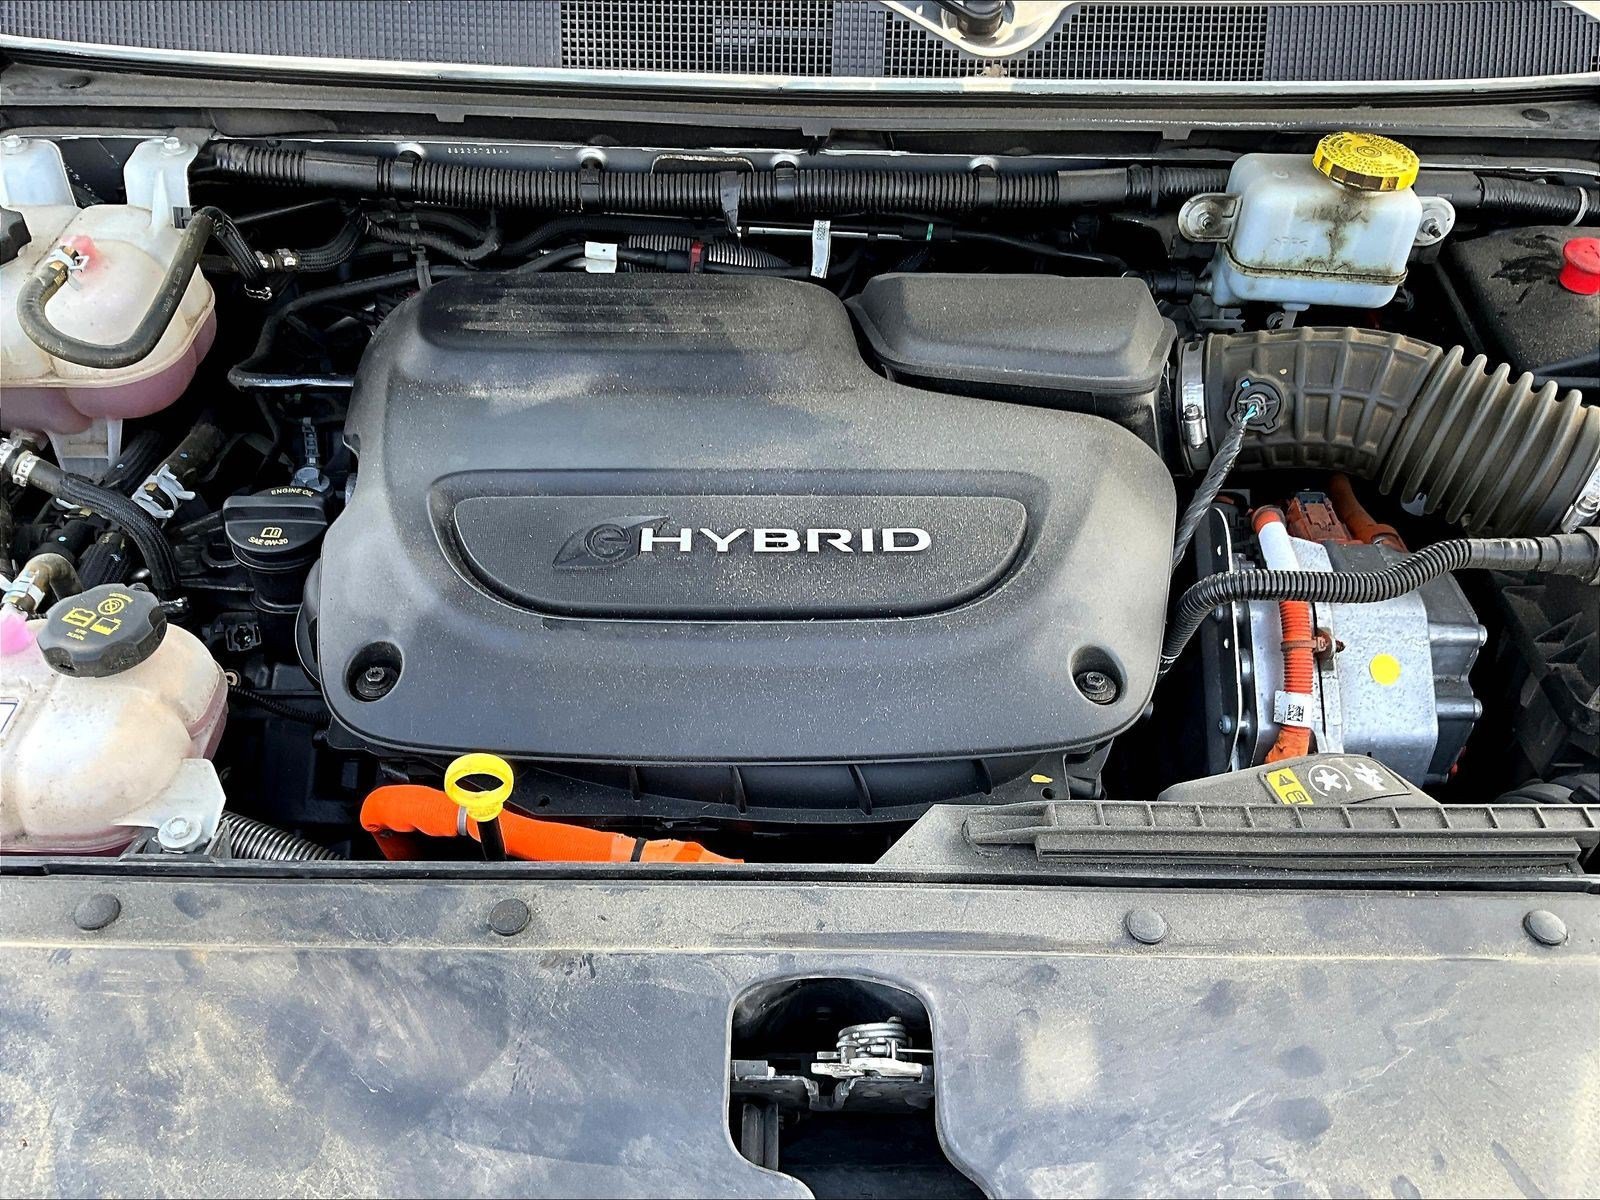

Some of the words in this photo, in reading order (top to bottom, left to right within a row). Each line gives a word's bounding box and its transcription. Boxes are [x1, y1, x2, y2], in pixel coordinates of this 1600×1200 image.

[271, 487, 301, 495] ENGINE
[248, 536, 263, 546] SAE
[264, 538, 289, 546] 0W-20
[640, 527, 932, 553] HYBRID
